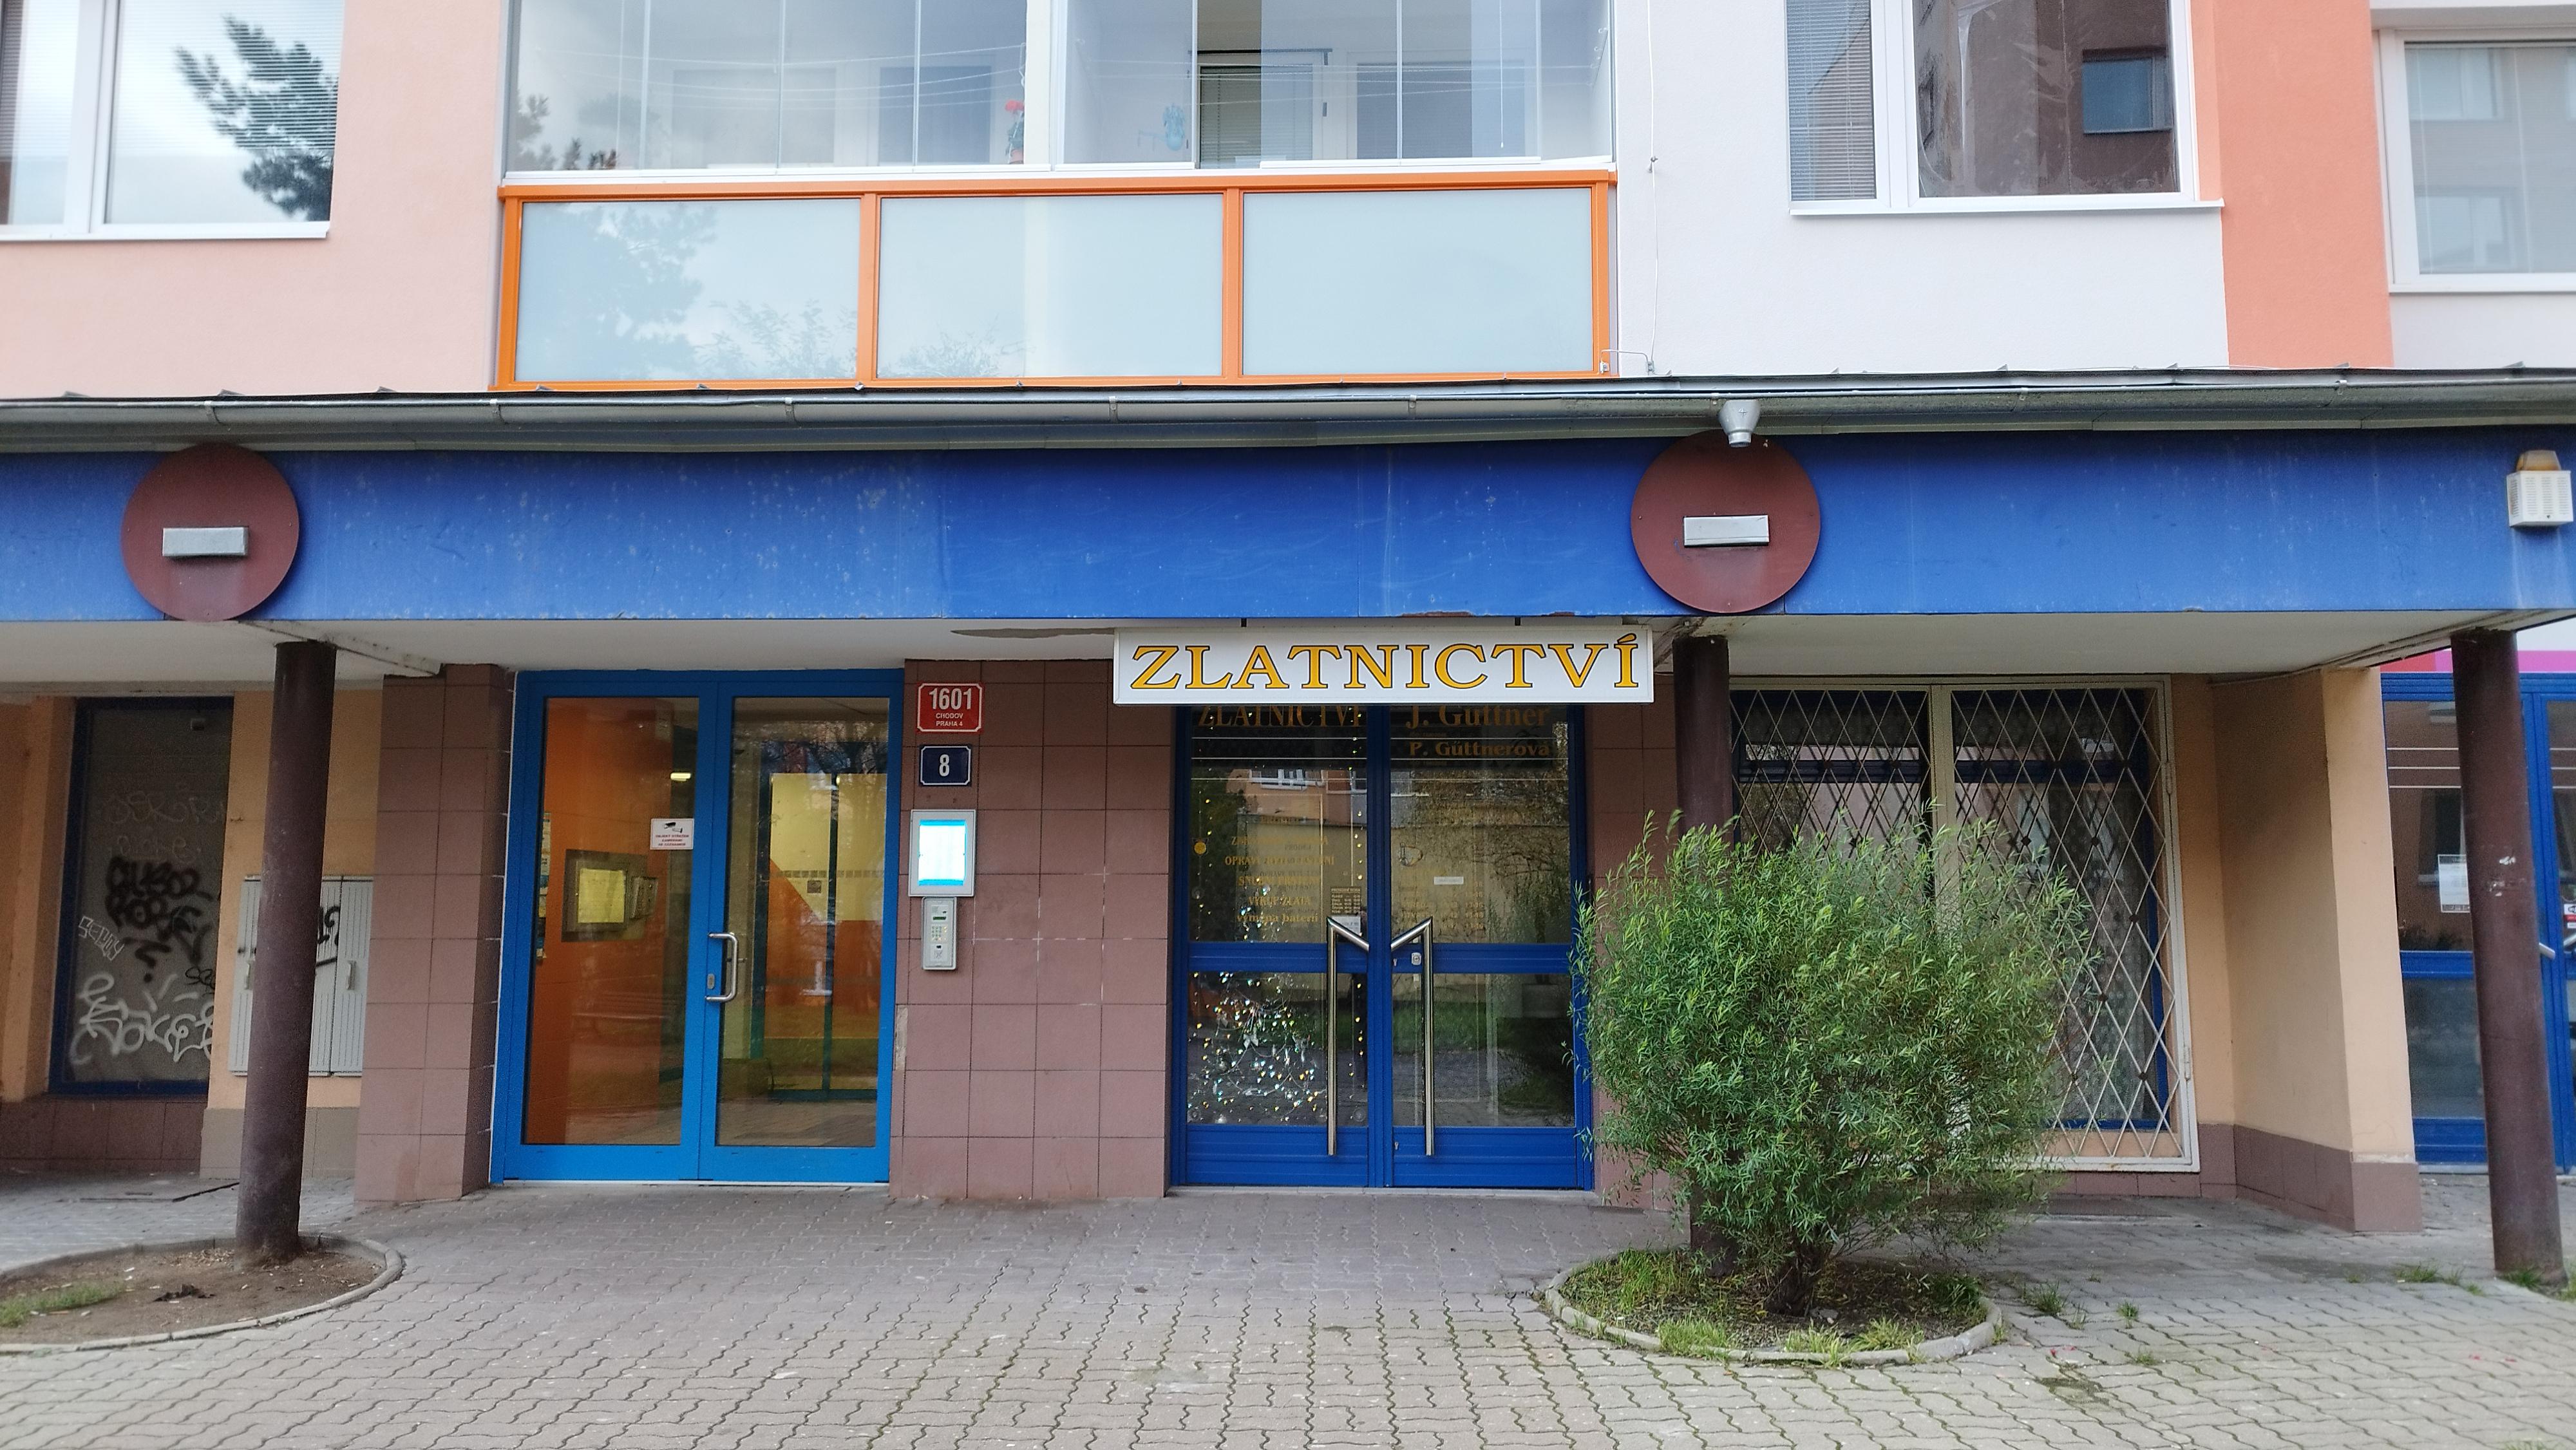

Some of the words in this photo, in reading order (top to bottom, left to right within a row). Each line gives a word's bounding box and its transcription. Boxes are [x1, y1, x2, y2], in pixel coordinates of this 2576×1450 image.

[1130, 632, 1639, 690] ZLATNICTVÍ
[929, 688, 972, 710] 1601
[1409, 741, 1428, 756] P.
[938, 753, 950, 778] 8
